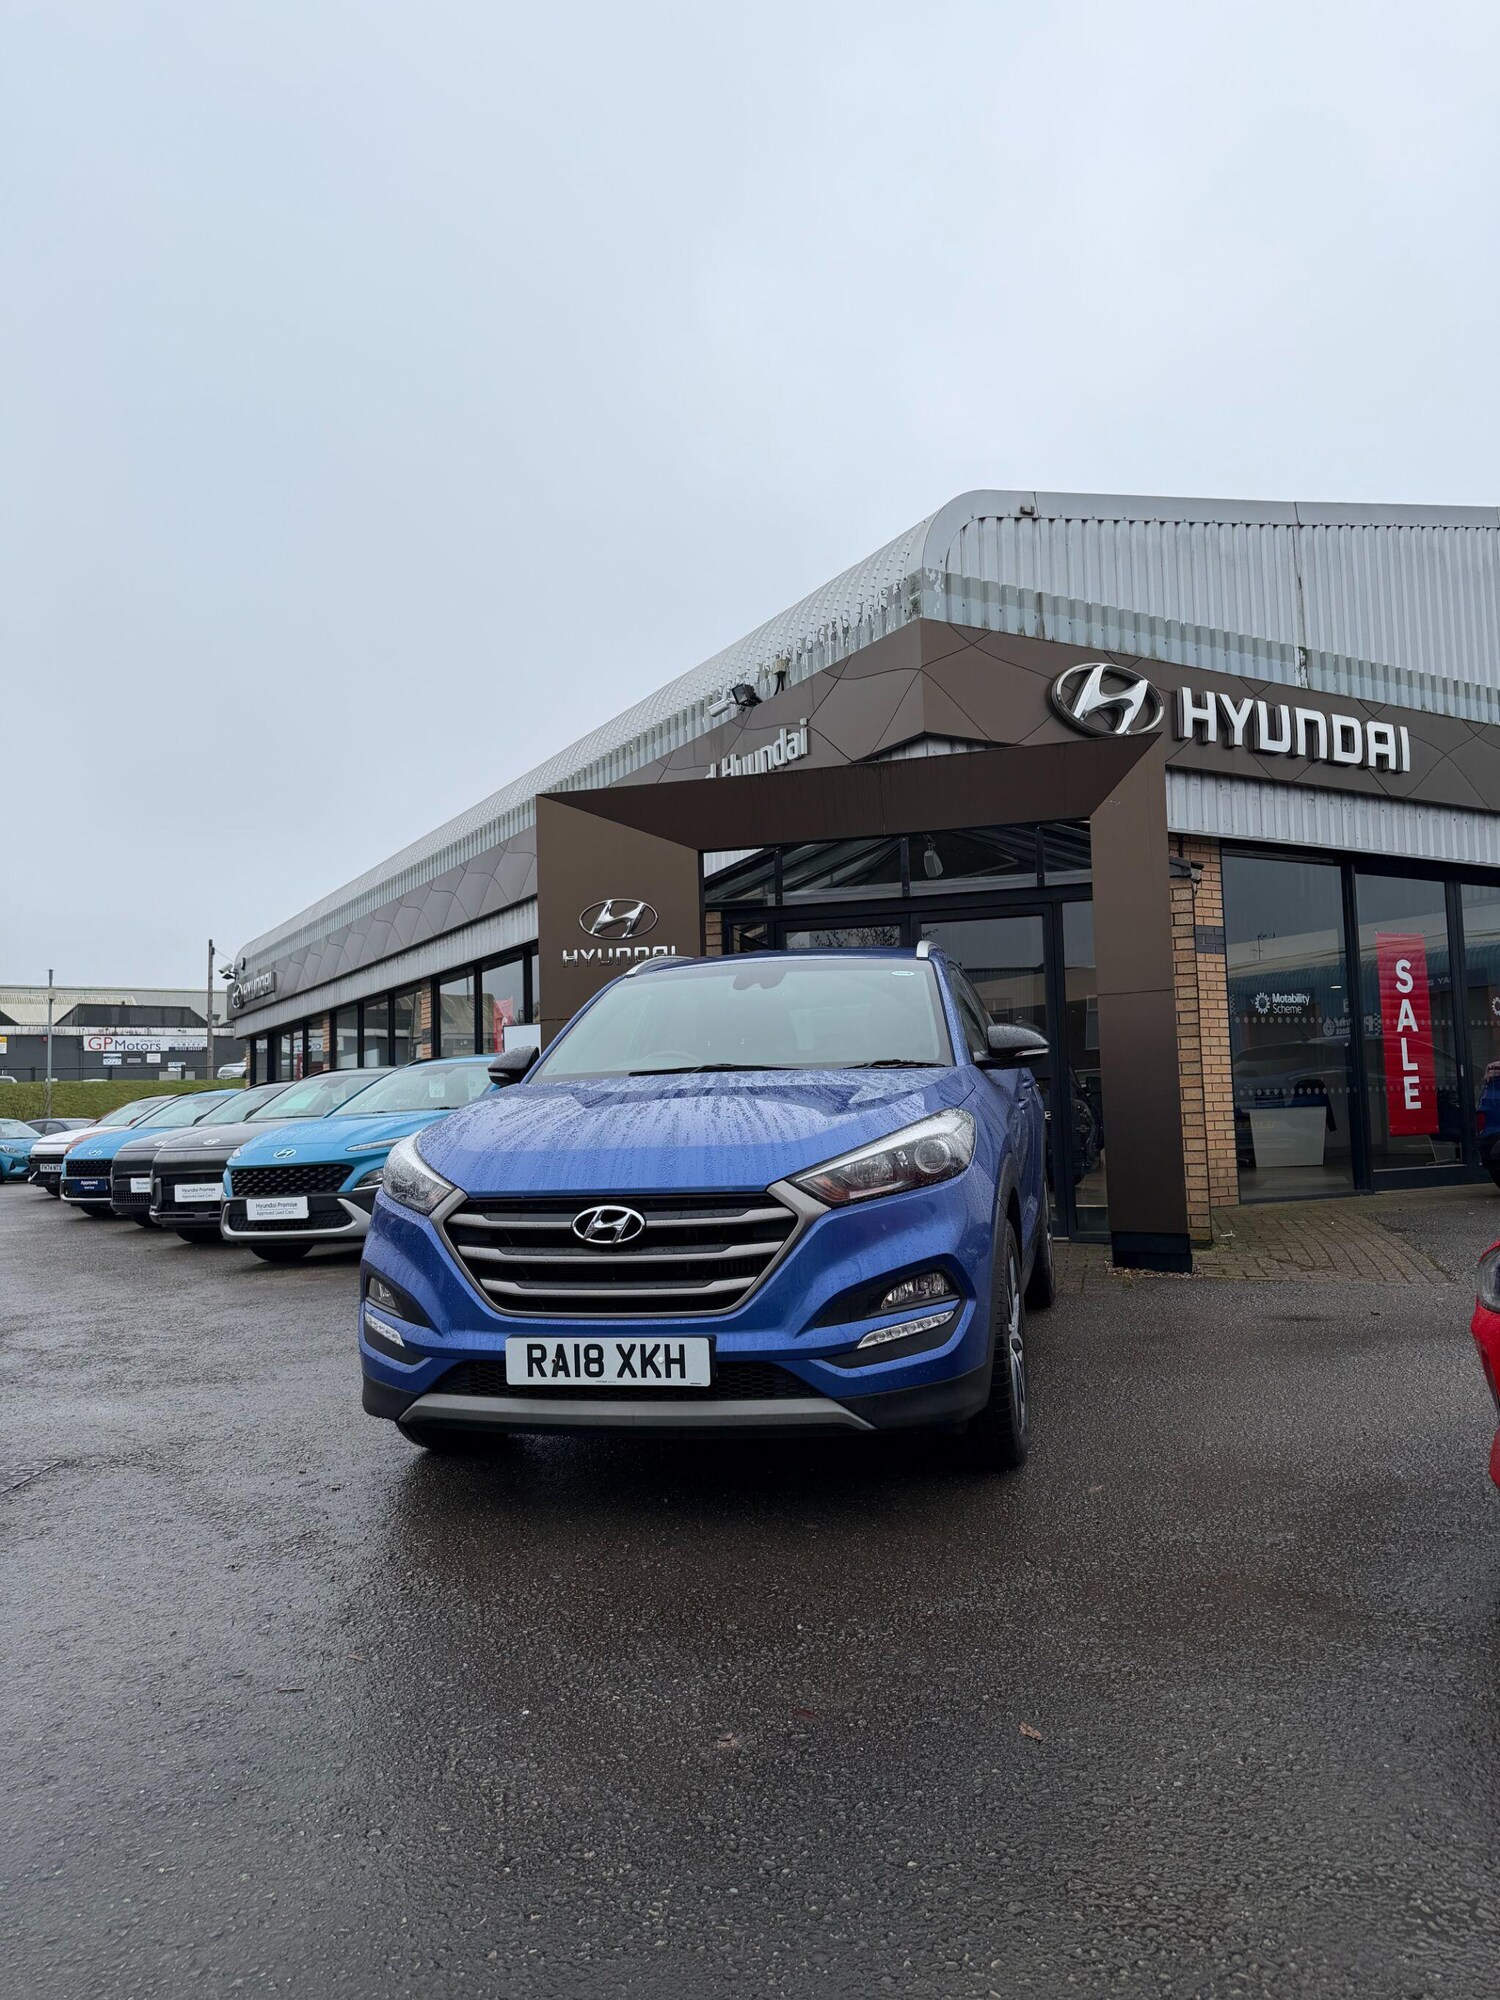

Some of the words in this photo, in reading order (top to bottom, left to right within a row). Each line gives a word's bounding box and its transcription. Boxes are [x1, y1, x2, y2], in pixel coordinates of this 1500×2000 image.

[1179, 686, 1411, 773] HYUNDAI
[562, 945, 676, 967] HYUNDAI
[1272, 993, 1310, 1006] Motability
[1273, 1004, 1302, 1014] Scheme
[1395, 959, 1422, 1110] SALE
[526, 1343, 604, 1378] RA18
[616, 1343, 686, 1379] XKH
